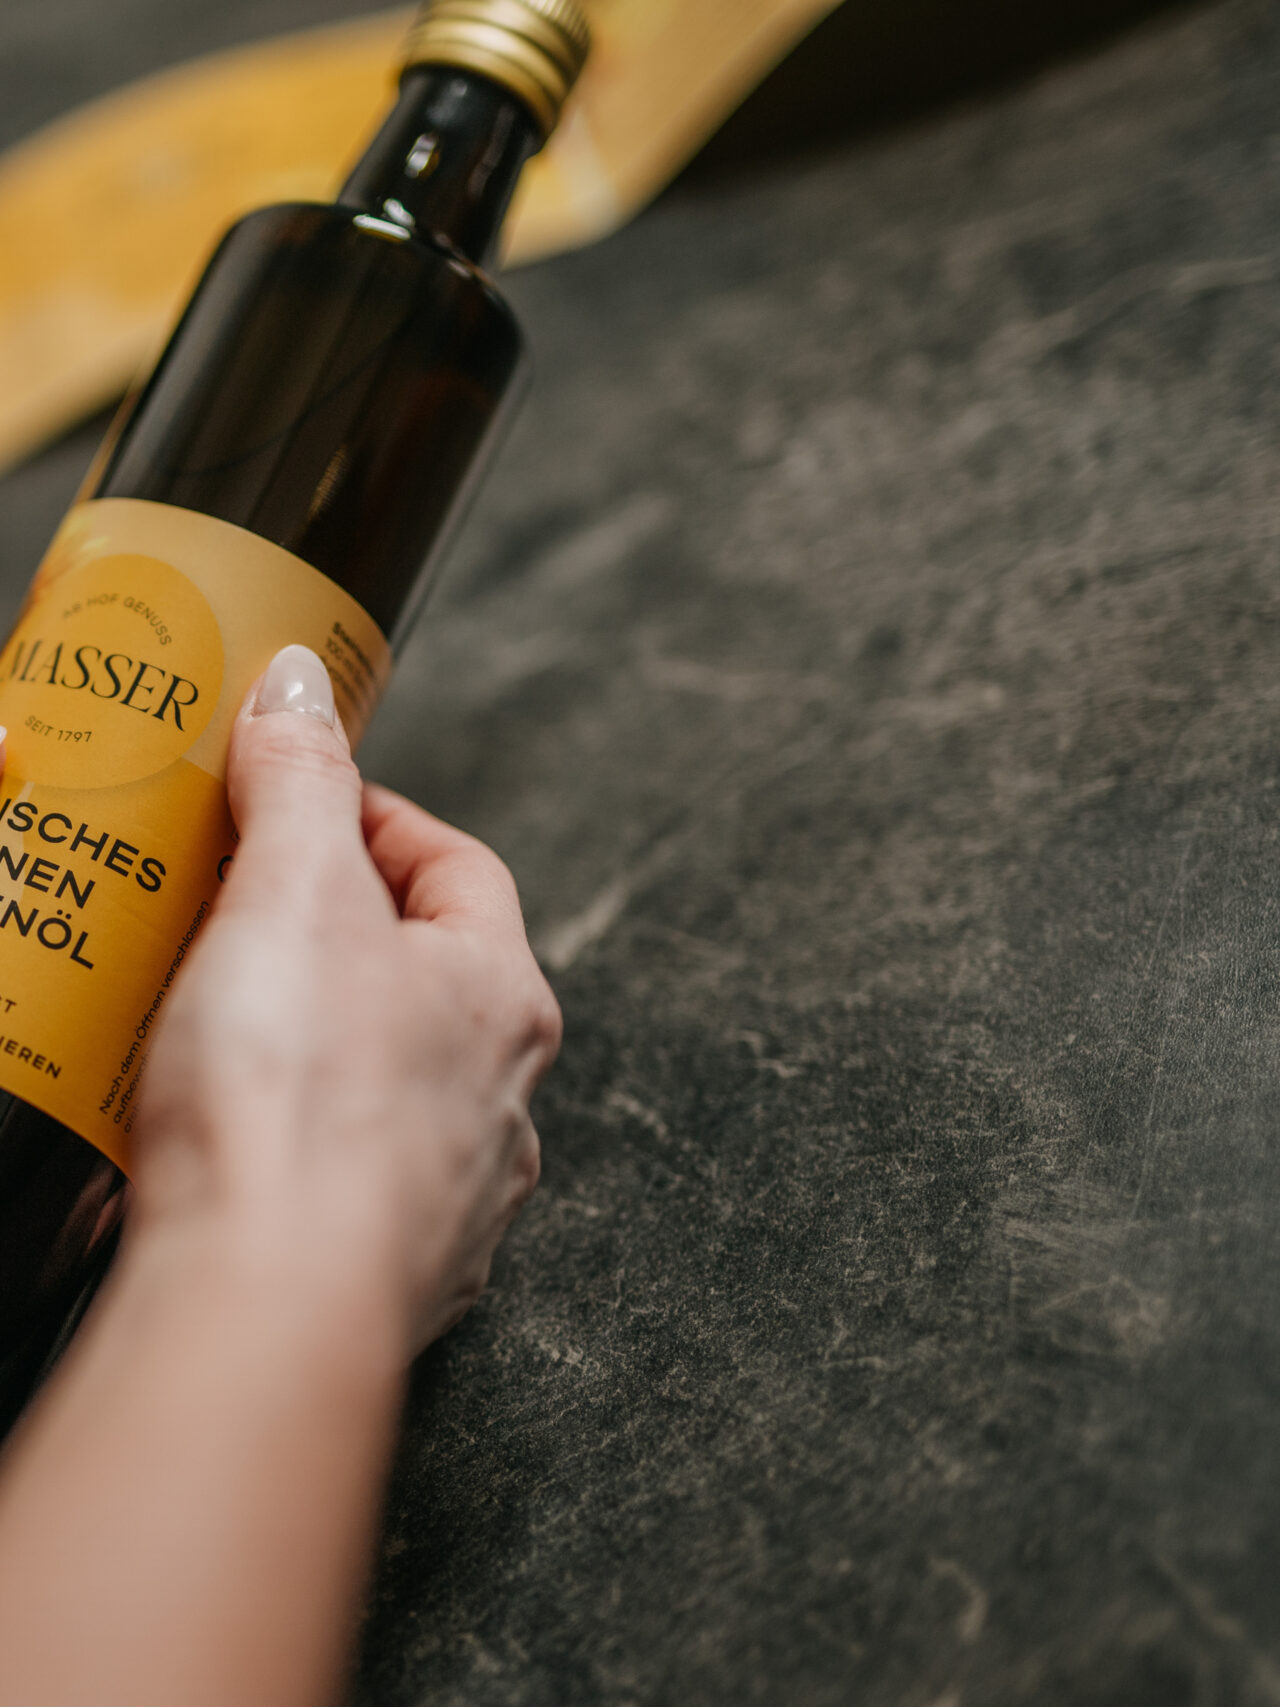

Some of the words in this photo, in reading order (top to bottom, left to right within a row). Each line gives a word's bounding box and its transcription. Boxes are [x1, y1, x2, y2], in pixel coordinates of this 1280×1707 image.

[123, 596, 172, 646] GENUSS
[25, 714, 54, 737] SEIT
[57, 729, 92, 743] 1797
[99, 1075, 124, 1115] Nach
[120, 1041, 141, 1074] dem
[135, 990, 166, 1039] Öffnen
[162, 900, 209, 988] verschlossen
